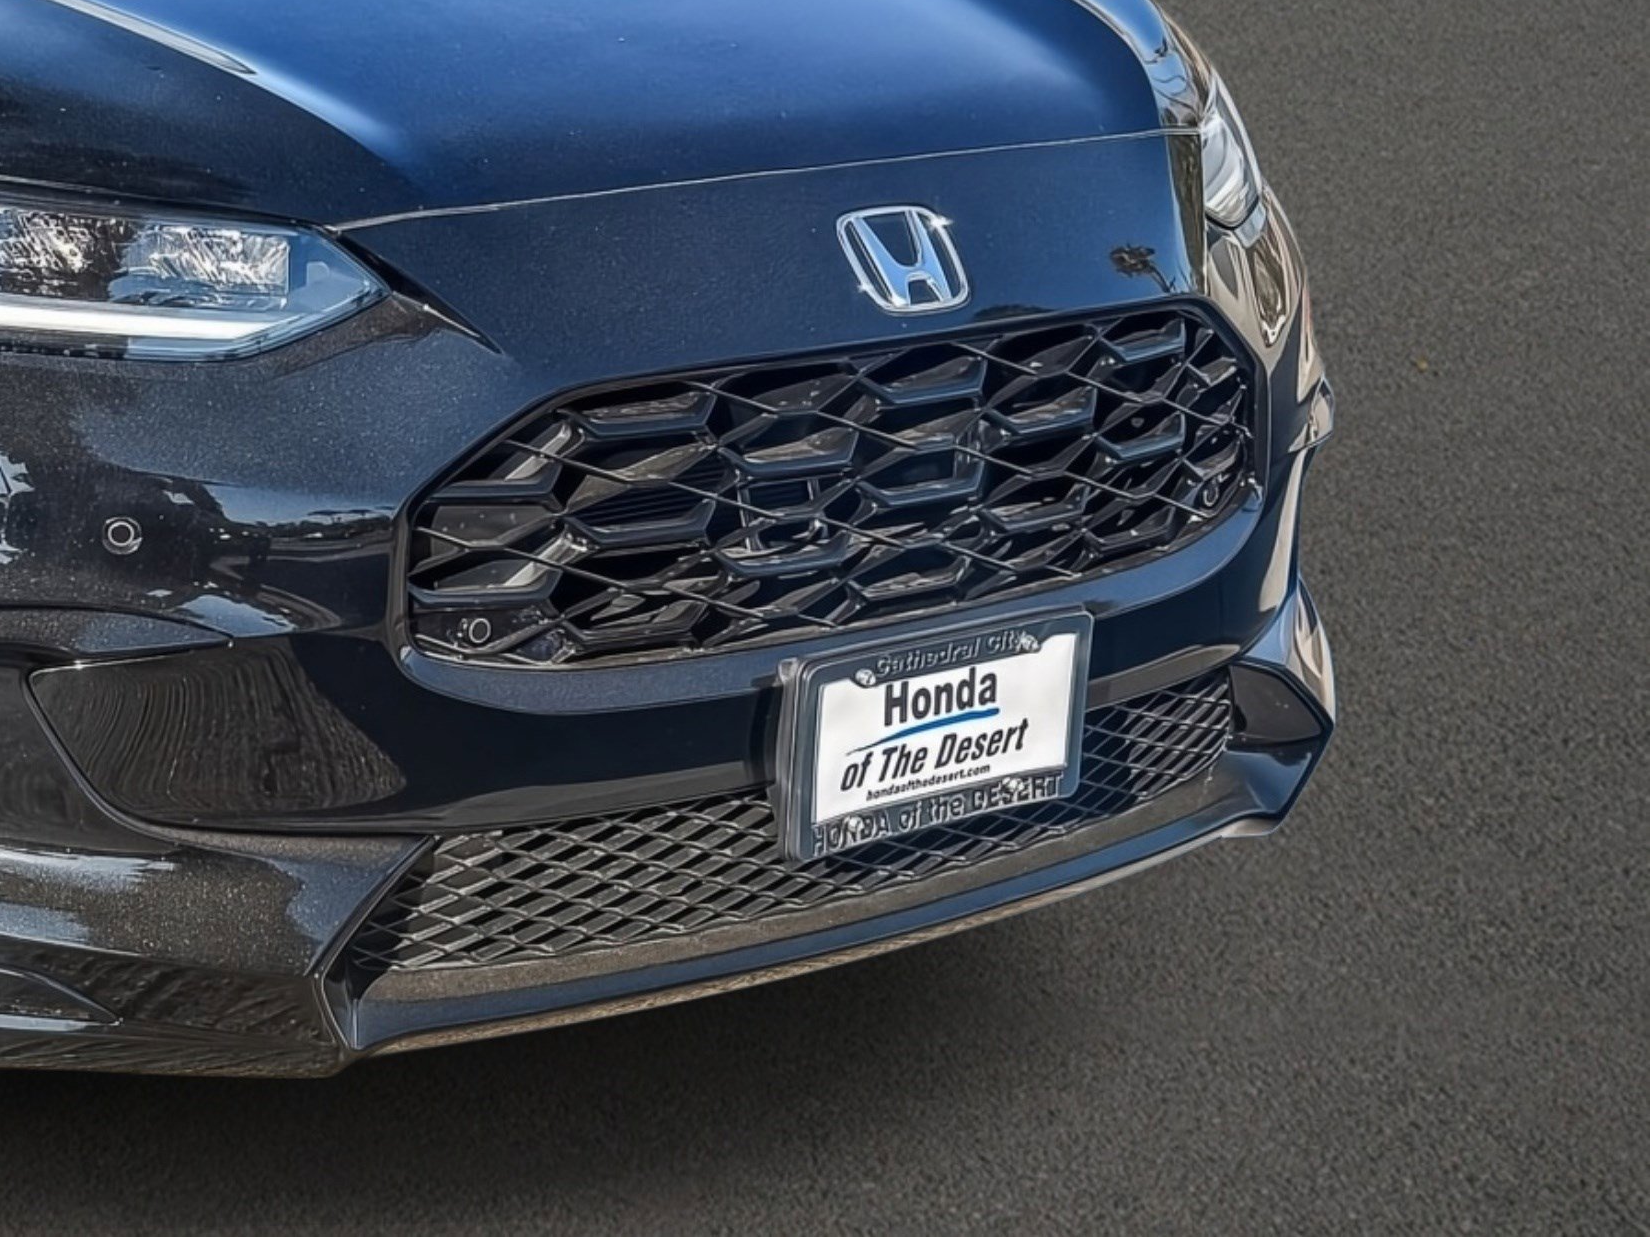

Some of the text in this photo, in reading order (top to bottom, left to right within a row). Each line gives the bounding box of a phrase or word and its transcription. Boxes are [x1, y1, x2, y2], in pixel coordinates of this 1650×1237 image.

[883, 666, 998, 727] Honda
[839, 717, 1029, 792] of The Desert
[865, 763, 991, 802] hondaofthedesert.com
